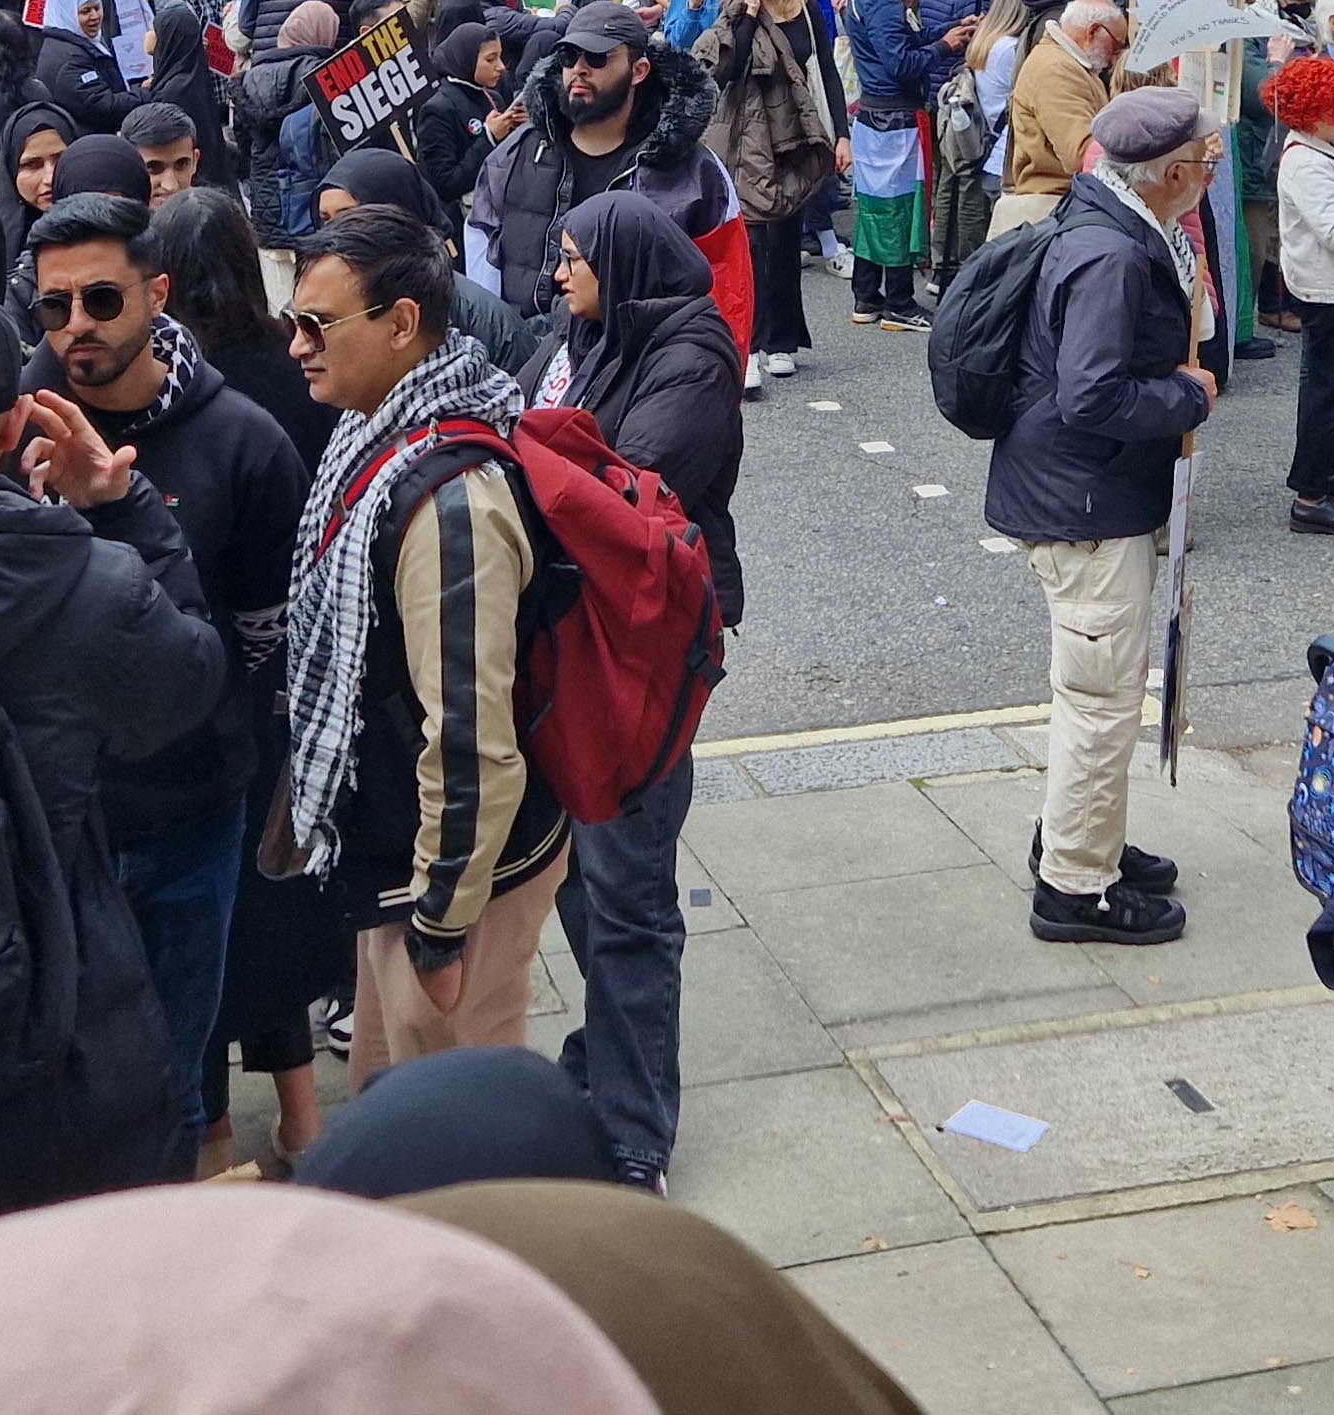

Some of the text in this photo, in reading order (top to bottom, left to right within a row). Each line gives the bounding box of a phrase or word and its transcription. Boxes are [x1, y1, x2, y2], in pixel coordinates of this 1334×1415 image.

[315, 16, 409, 104] END THE
[1198, 23, 1211, 33] NO
[1211, 16, 1250, 28] THANKS
[330, 44, 428, 141] SIEGE
